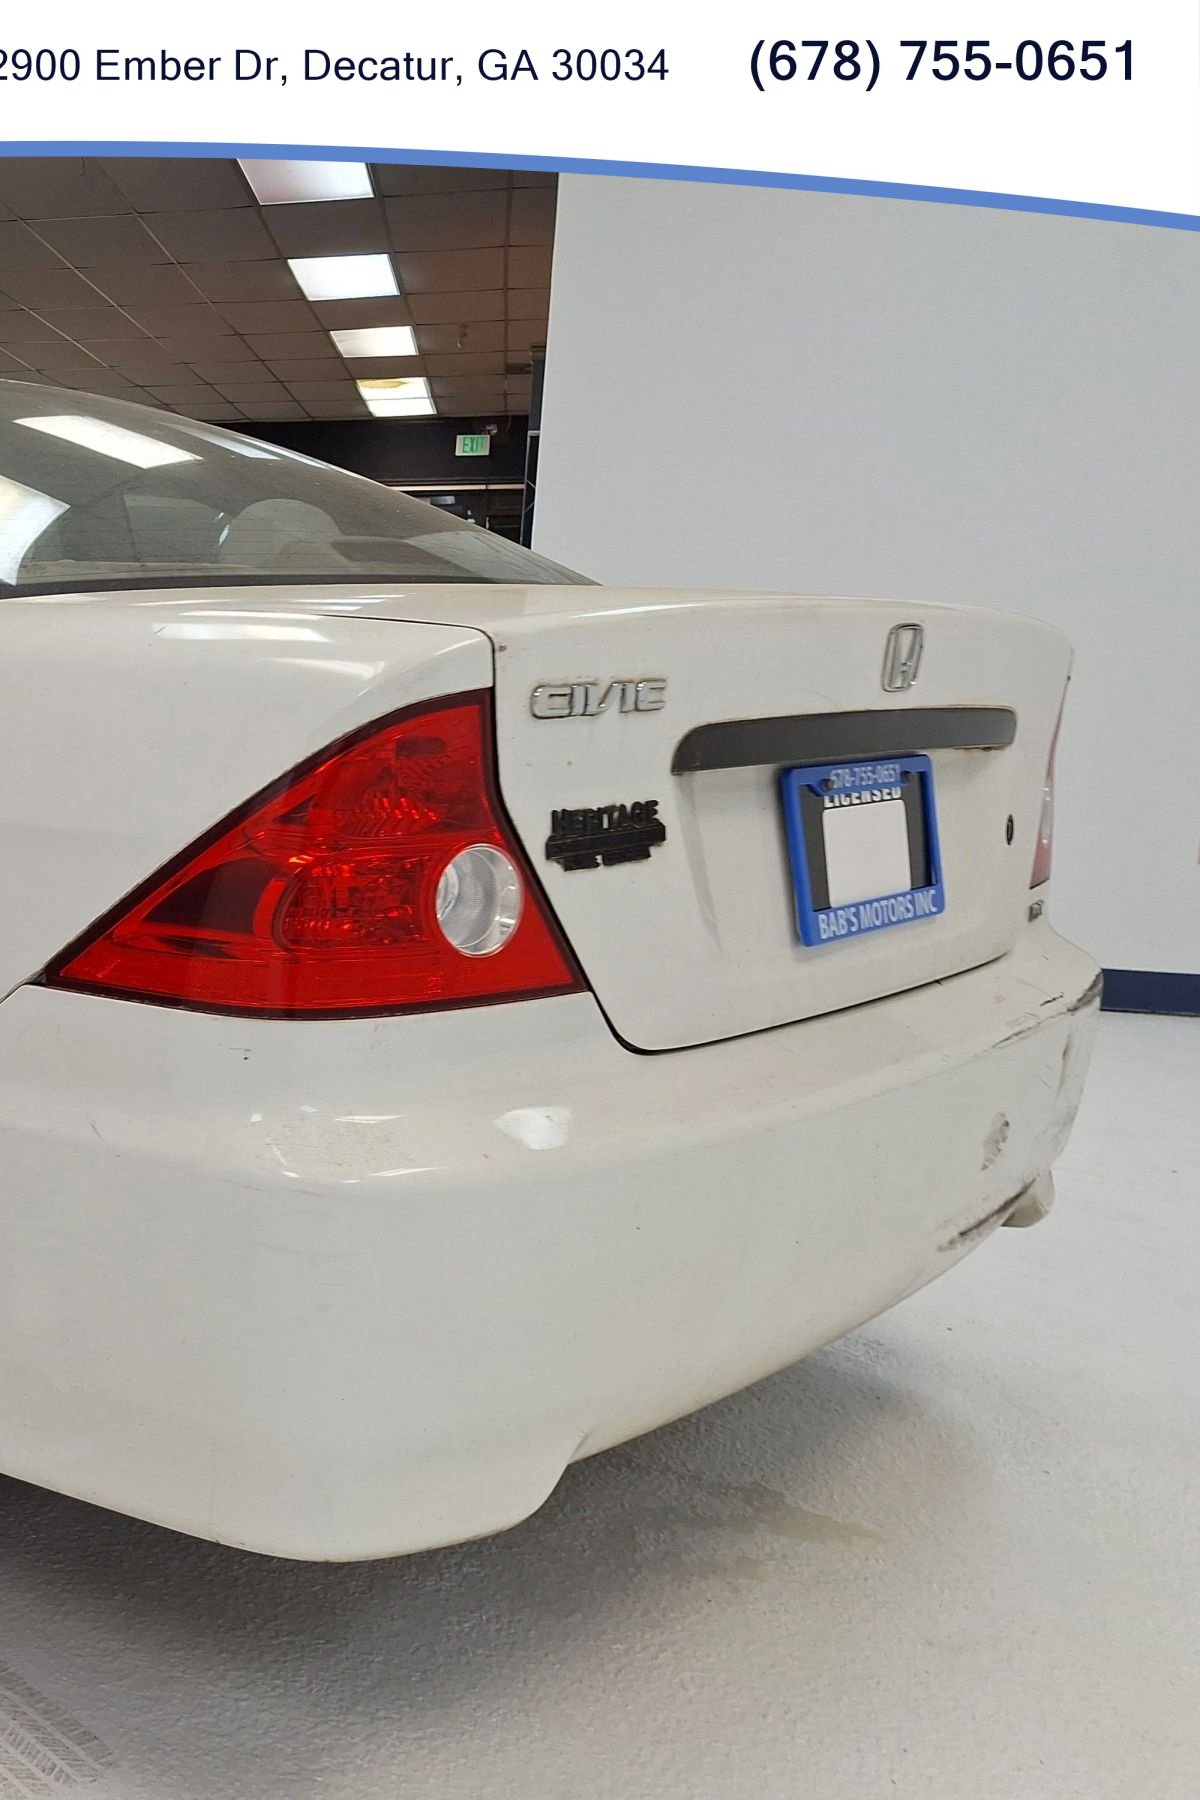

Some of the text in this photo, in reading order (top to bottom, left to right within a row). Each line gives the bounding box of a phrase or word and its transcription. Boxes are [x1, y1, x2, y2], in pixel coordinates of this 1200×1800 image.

[463, 437, 485, 453] EXIT
[529, 678, 667, 719] CIVIC
[551, 799, 660, 838] HERITAGE
[818, 888, 938, 940] BAB'S MOTORS INC
